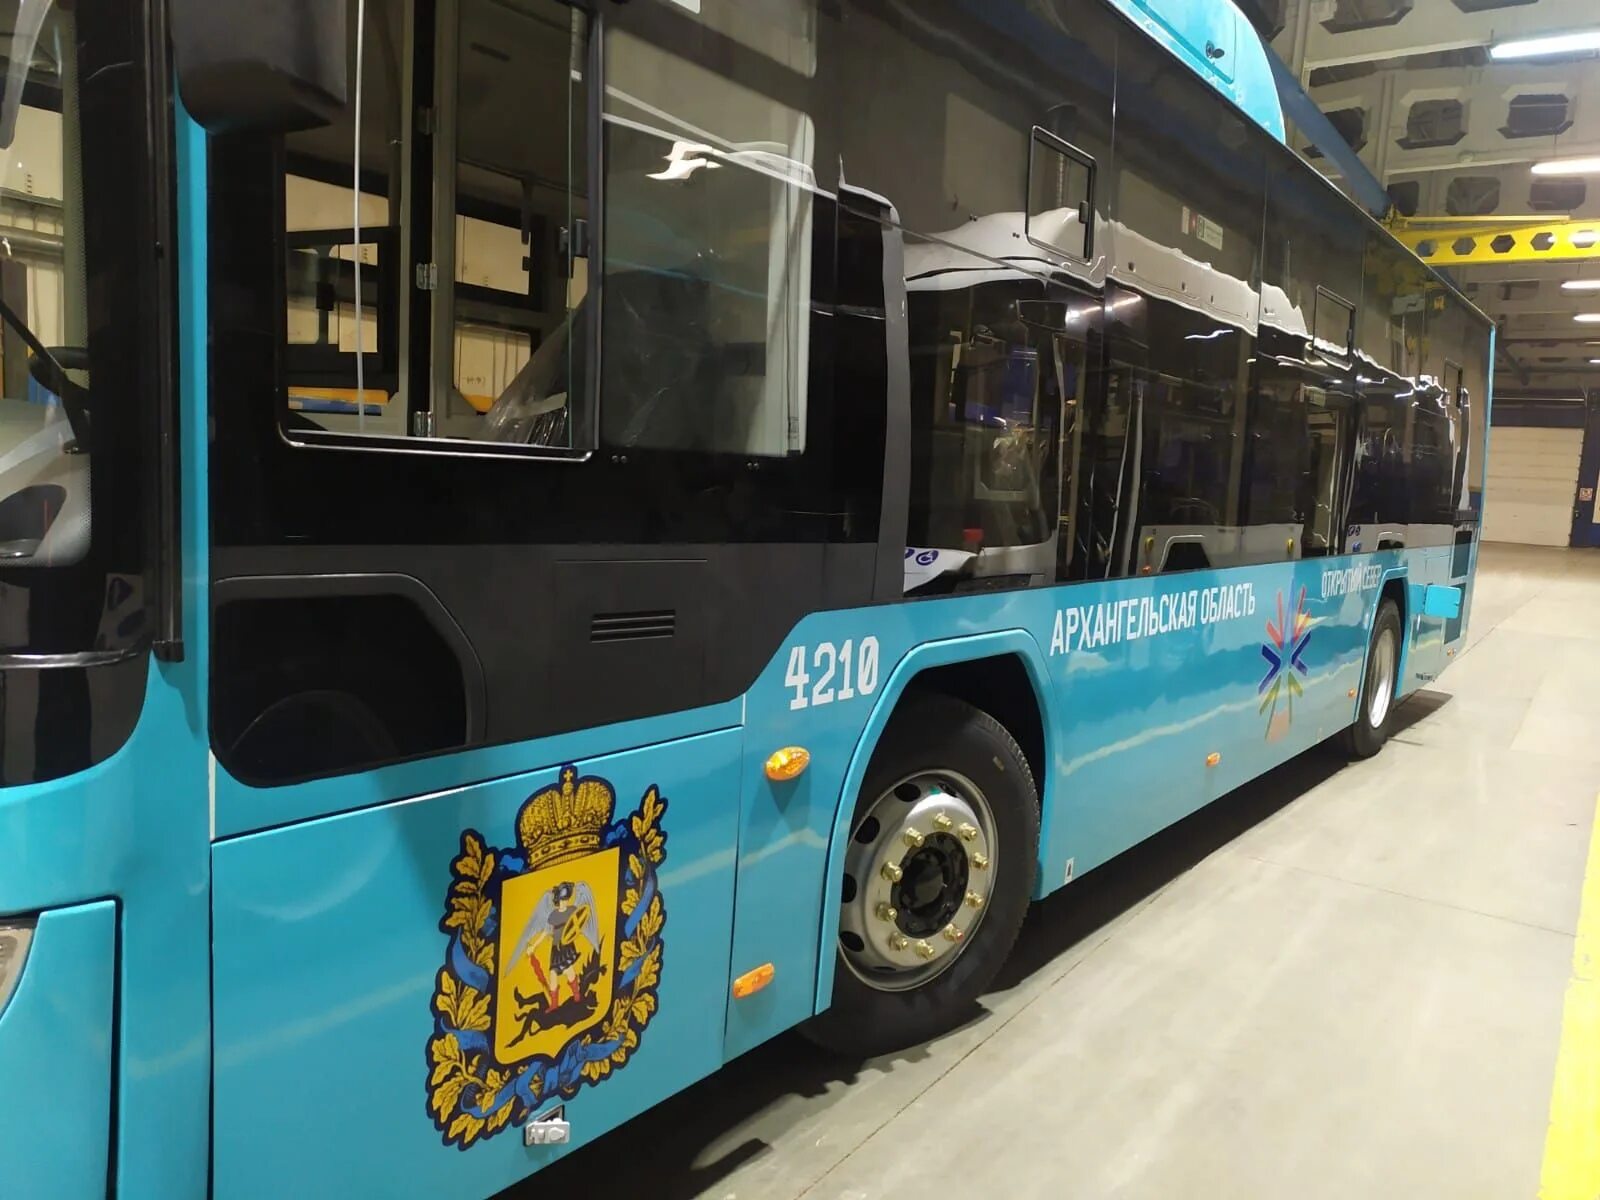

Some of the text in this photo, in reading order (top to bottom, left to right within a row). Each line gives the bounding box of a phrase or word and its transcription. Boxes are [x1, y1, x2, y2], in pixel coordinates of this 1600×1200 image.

[1321, 562, 1362, 598] ОТКРЫТЫЙ
[1050, 583, 1255, 657] АРХАНГЕЛЬСКАЯ ОБЛАСТЬ
[784, 635, 879, 711] 4210
